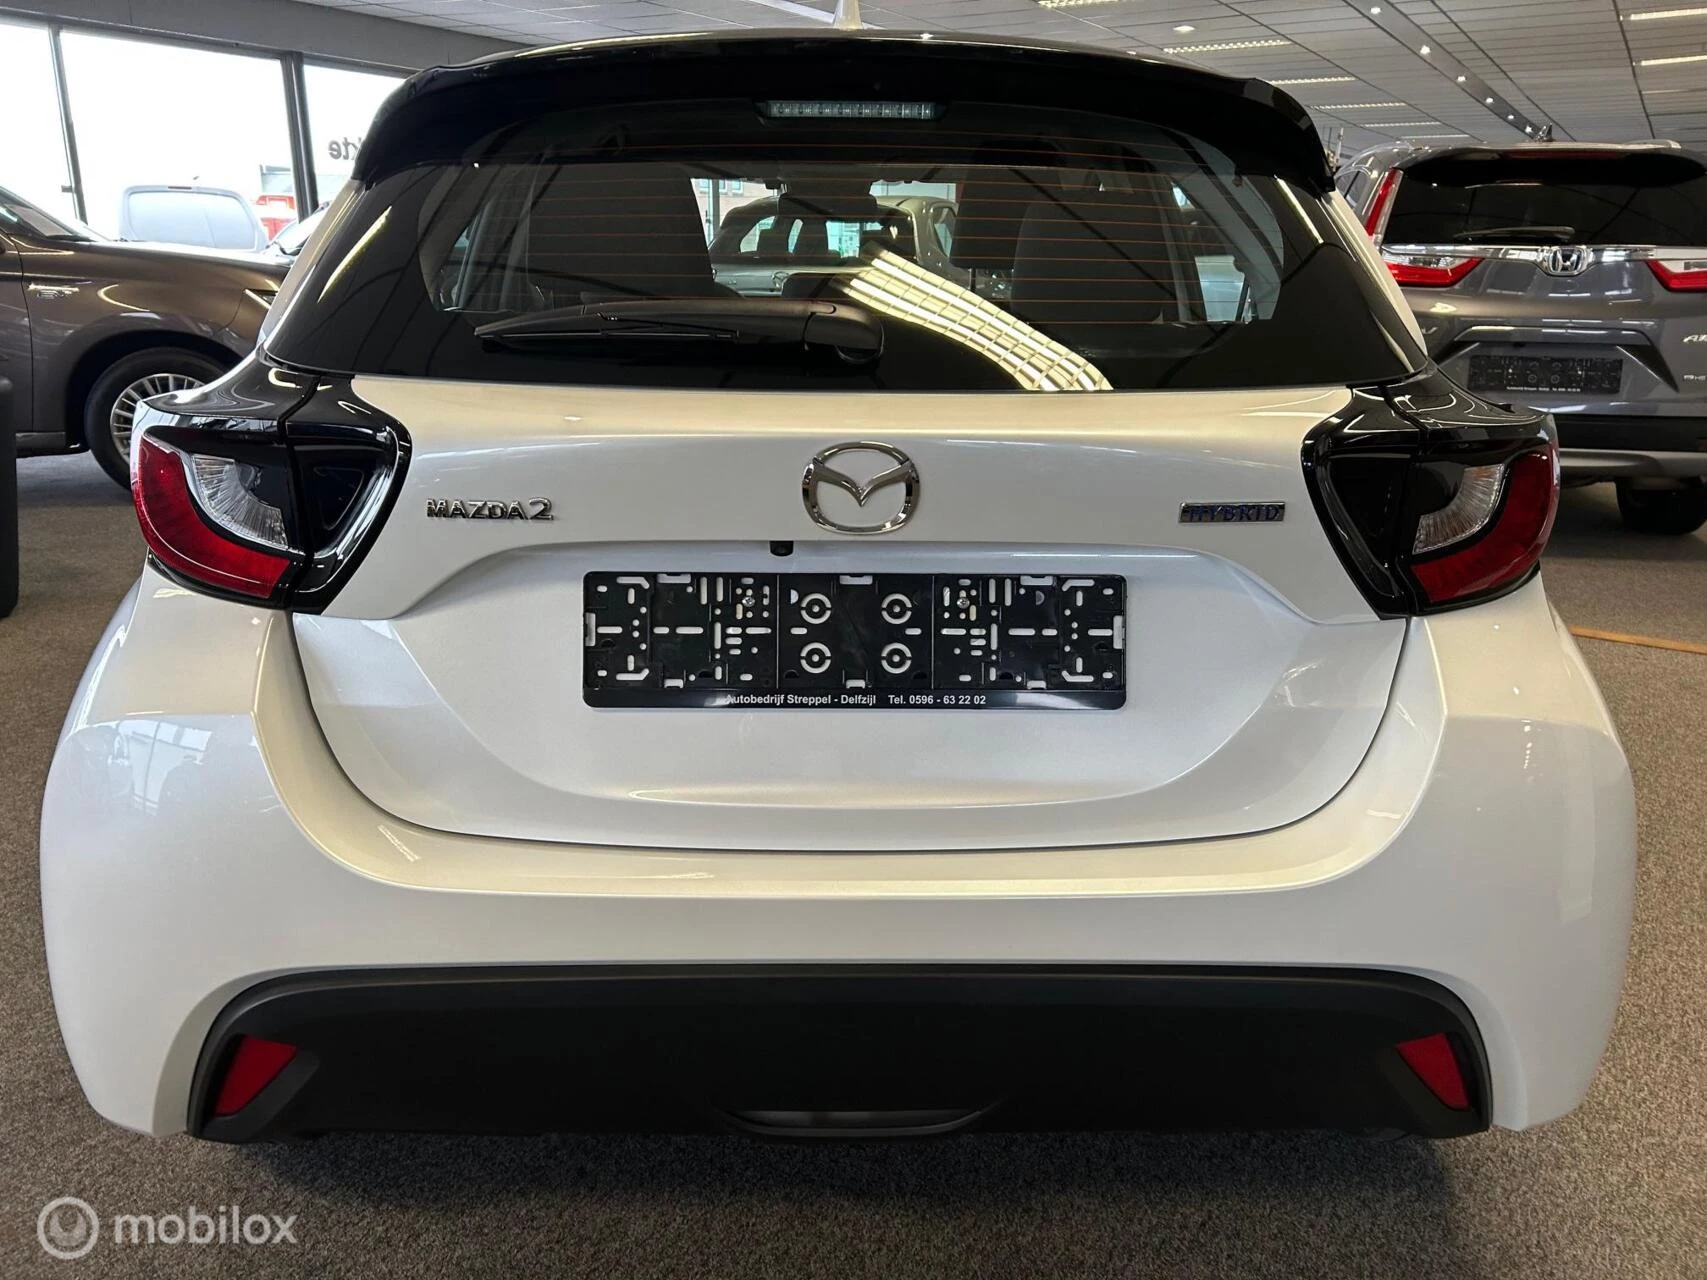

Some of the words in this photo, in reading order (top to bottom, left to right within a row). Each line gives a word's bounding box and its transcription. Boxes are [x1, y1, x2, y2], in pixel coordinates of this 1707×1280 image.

[1184, 503, 1282, 521] HYBRID
[727, 694, 785, 706] Autobedrijf
[787, 694, 831, 706] Streppel
[841, 694, 876, 706] Delfzijl
[888, 695, 906, 704] Tel.
[909, 695, 934, 705] 0596
[943, 695, 956, 705] 63
[958, 695, 971, 705] 22
[973, 695, 986, 705] 02
